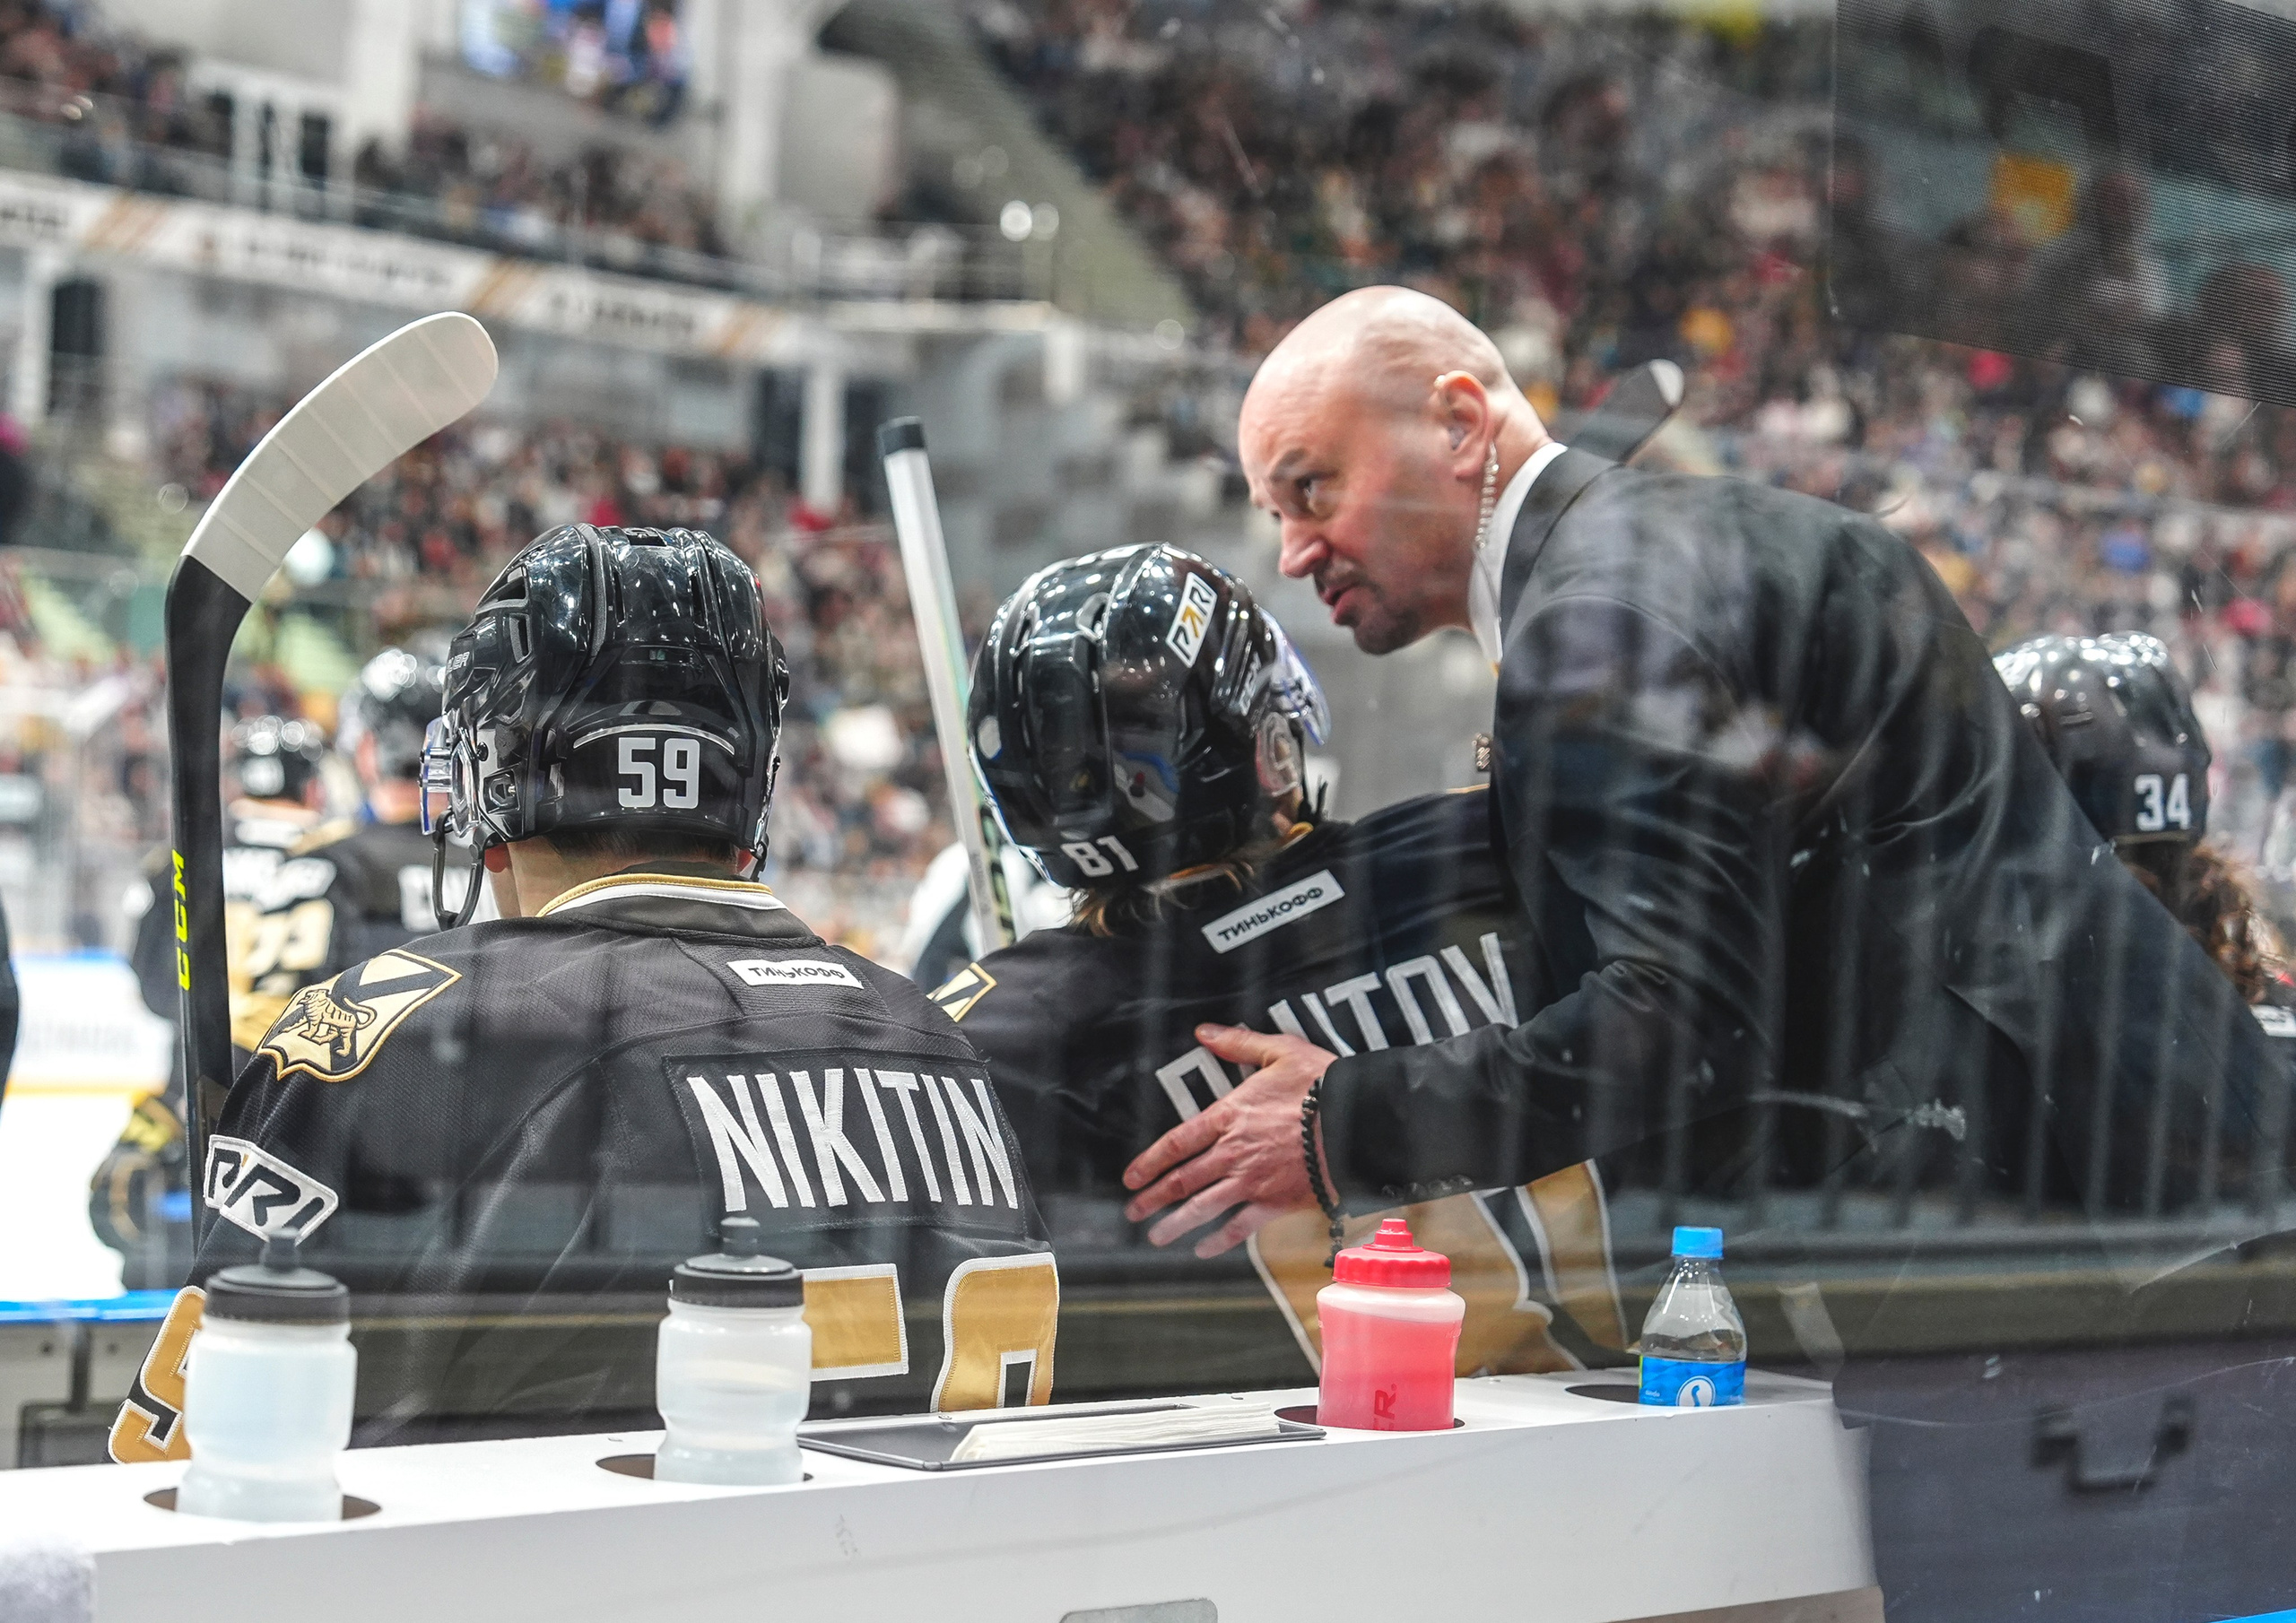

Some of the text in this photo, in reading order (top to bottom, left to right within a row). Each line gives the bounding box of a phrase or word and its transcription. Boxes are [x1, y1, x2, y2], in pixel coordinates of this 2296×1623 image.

[618, 737, 700, 810] 59
[2135, 773, 2191, 831] 34
[1060, 835, 1139, 878] 81
[171, 848, 191, 991] CCM
[1217, 886, 1324, 942] ТИНЬКОФФ
[686, 1068, 1018, 1212] NIKITIN
[207, 1147, 325, 1228] PRI
